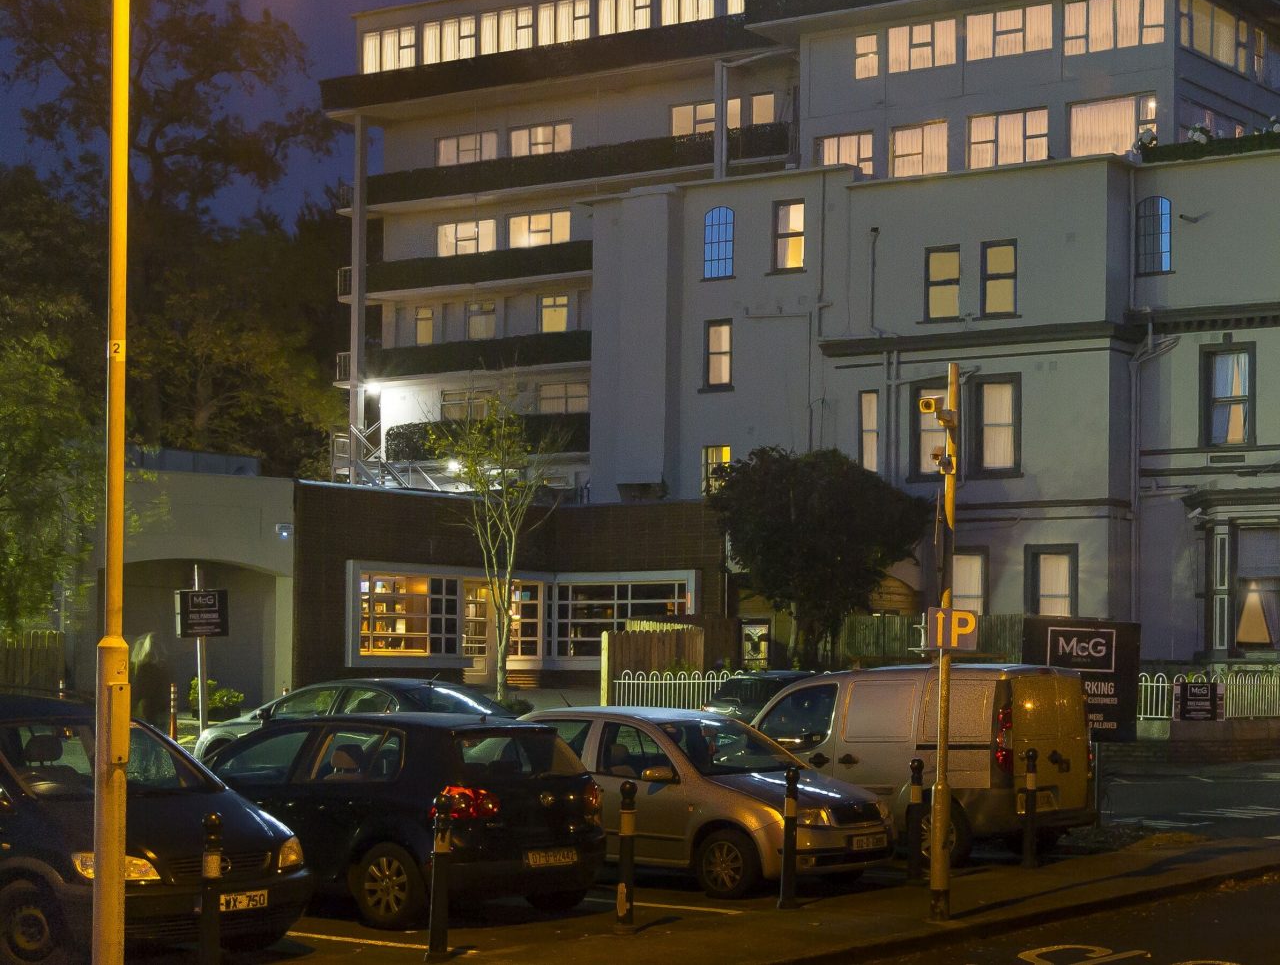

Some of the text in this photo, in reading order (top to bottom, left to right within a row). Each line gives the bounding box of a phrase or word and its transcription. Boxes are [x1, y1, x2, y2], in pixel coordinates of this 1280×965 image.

[113, 343, 120, 354] 2
[951, 611, 976, 647] P
[1058, 636, 1106, 657] McG
[1084, 681, 1115, 695] RKING
